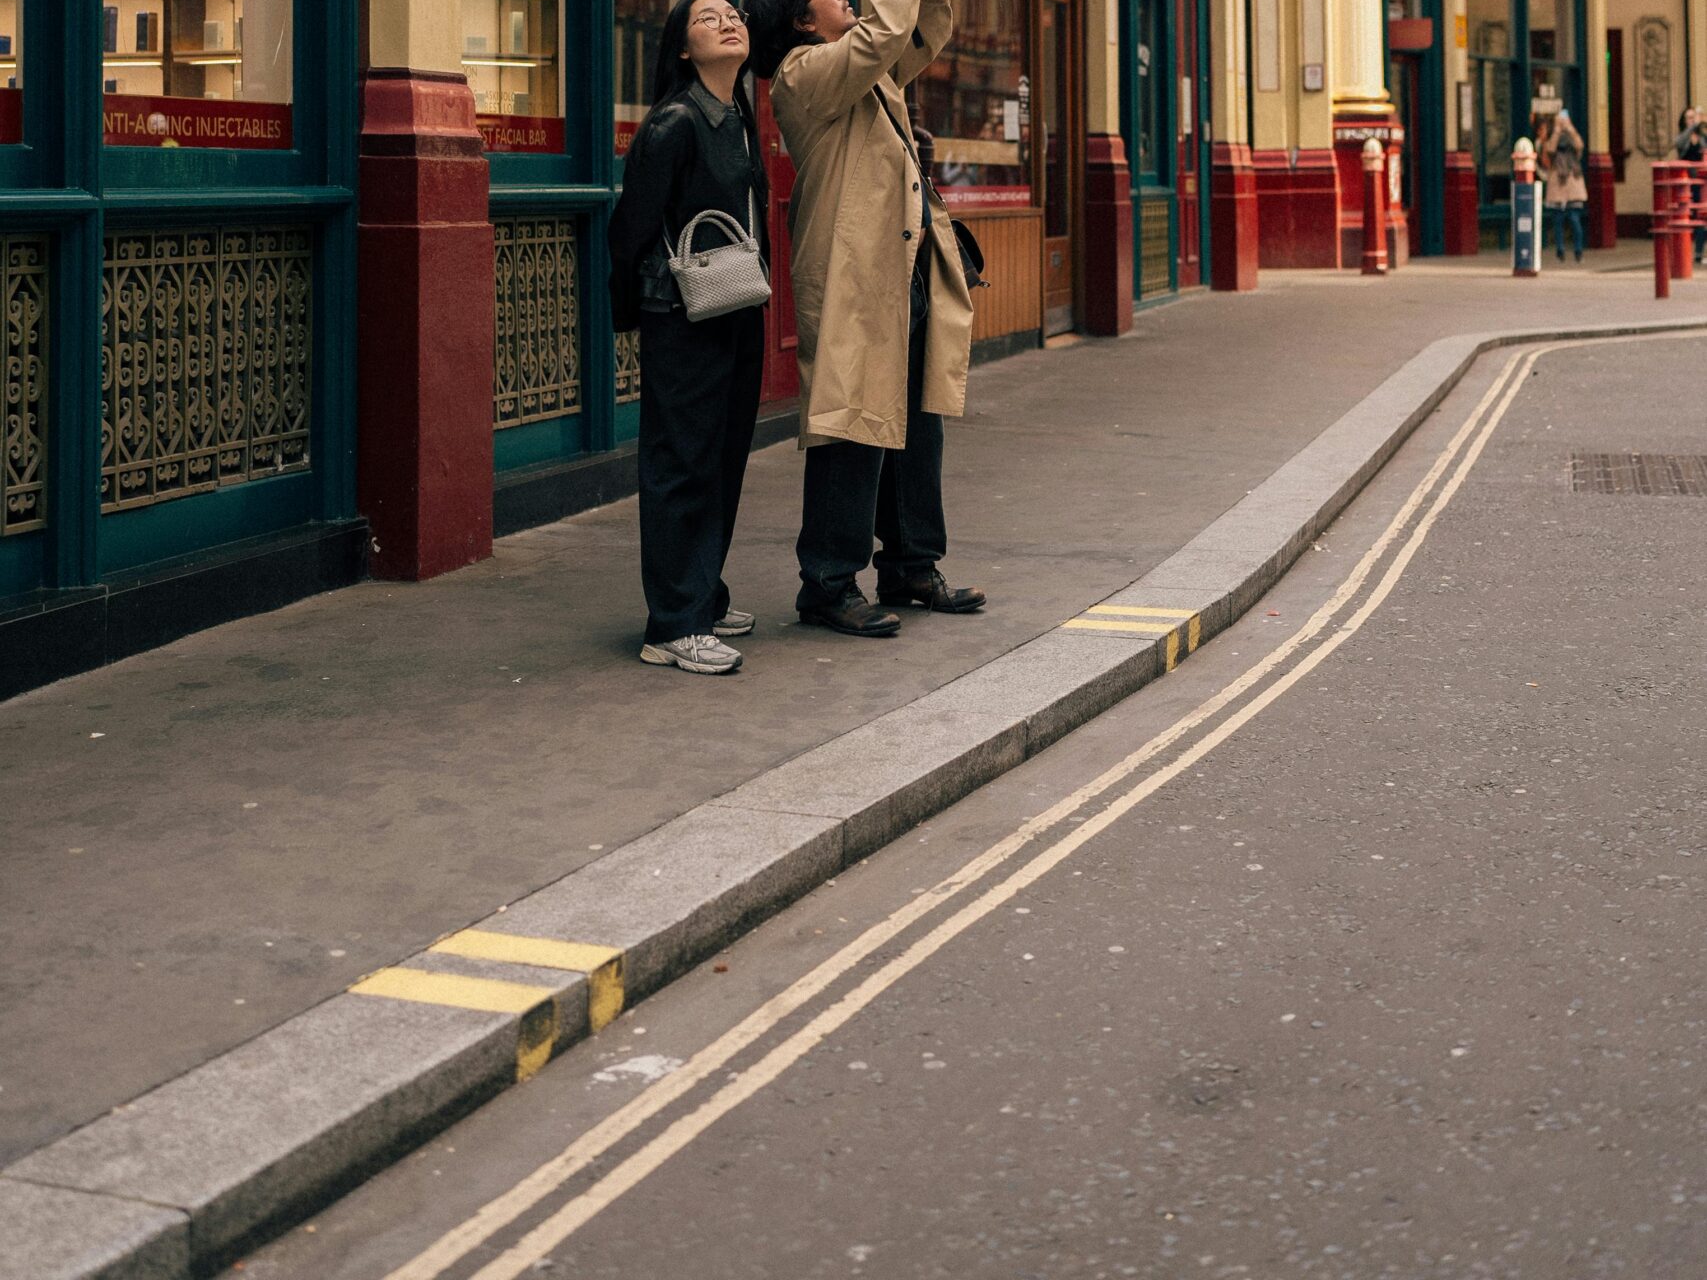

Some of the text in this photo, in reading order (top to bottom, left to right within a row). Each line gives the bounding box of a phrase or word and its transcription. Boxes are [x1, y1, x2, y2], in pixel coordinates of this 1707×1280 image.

[196, 117, 281, 139] INJECTABLES
[495, 128, 528, 145] FACIAL
[529, 130, 547, 146] BAR
